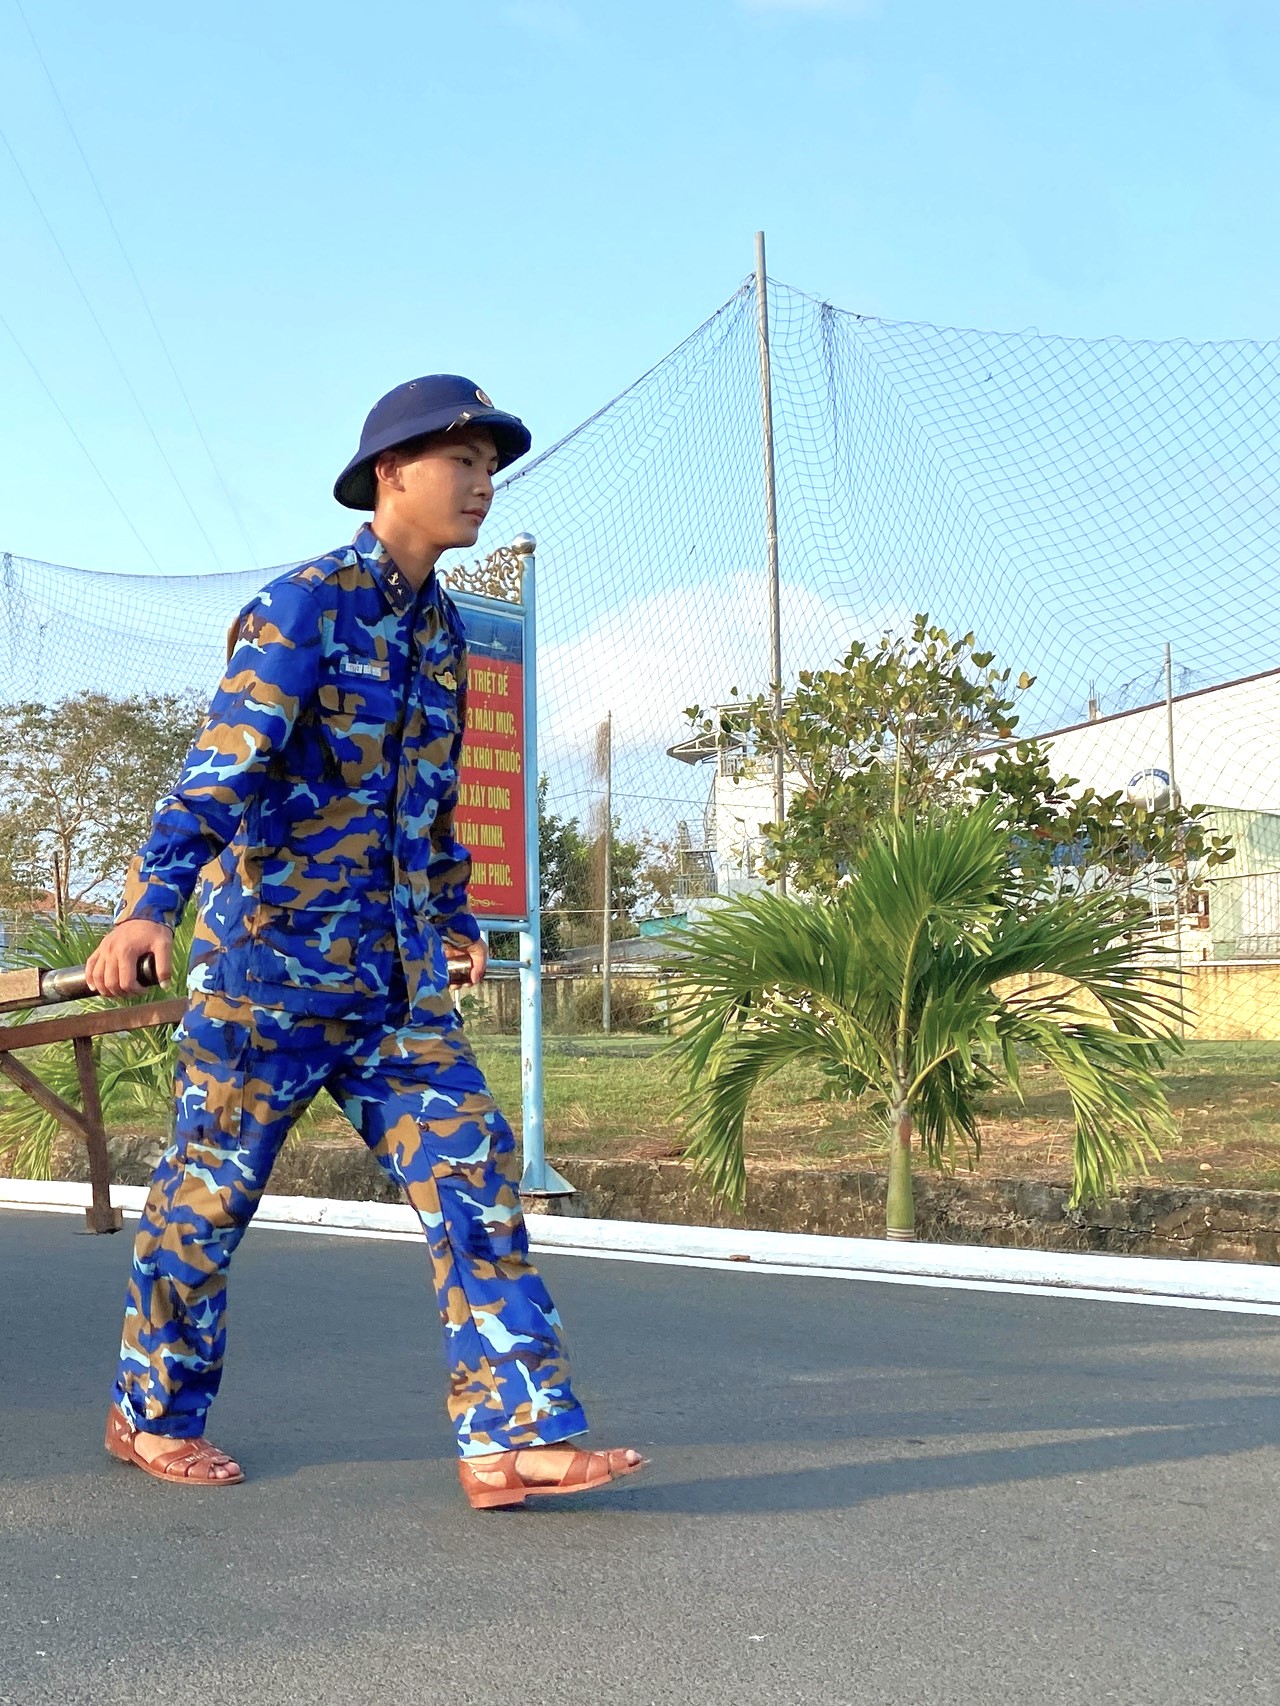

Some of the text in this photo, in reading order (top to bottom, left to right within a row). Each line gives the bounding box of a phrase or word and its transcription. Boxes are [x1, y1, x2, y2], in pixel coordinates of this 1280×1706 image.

[473, 666, 496, 699] TRIỆT
[498, 665, 509, 697] ĐỂ
[475, 700, 494, 732] MẪU
[495, 710, 517, 739] MỰC,
[473, 743, 493, 770] KHÓI
[495, 743, 521, 774] THUỐC
[469, 780, 486, 808] XÂY
[487, 785, 511, 814] DỰNG
[461, 817, 478, 846] VĂN
[480, 824, 506, 851] MINH,
[488, 859, 514, 887] PHÚC.
